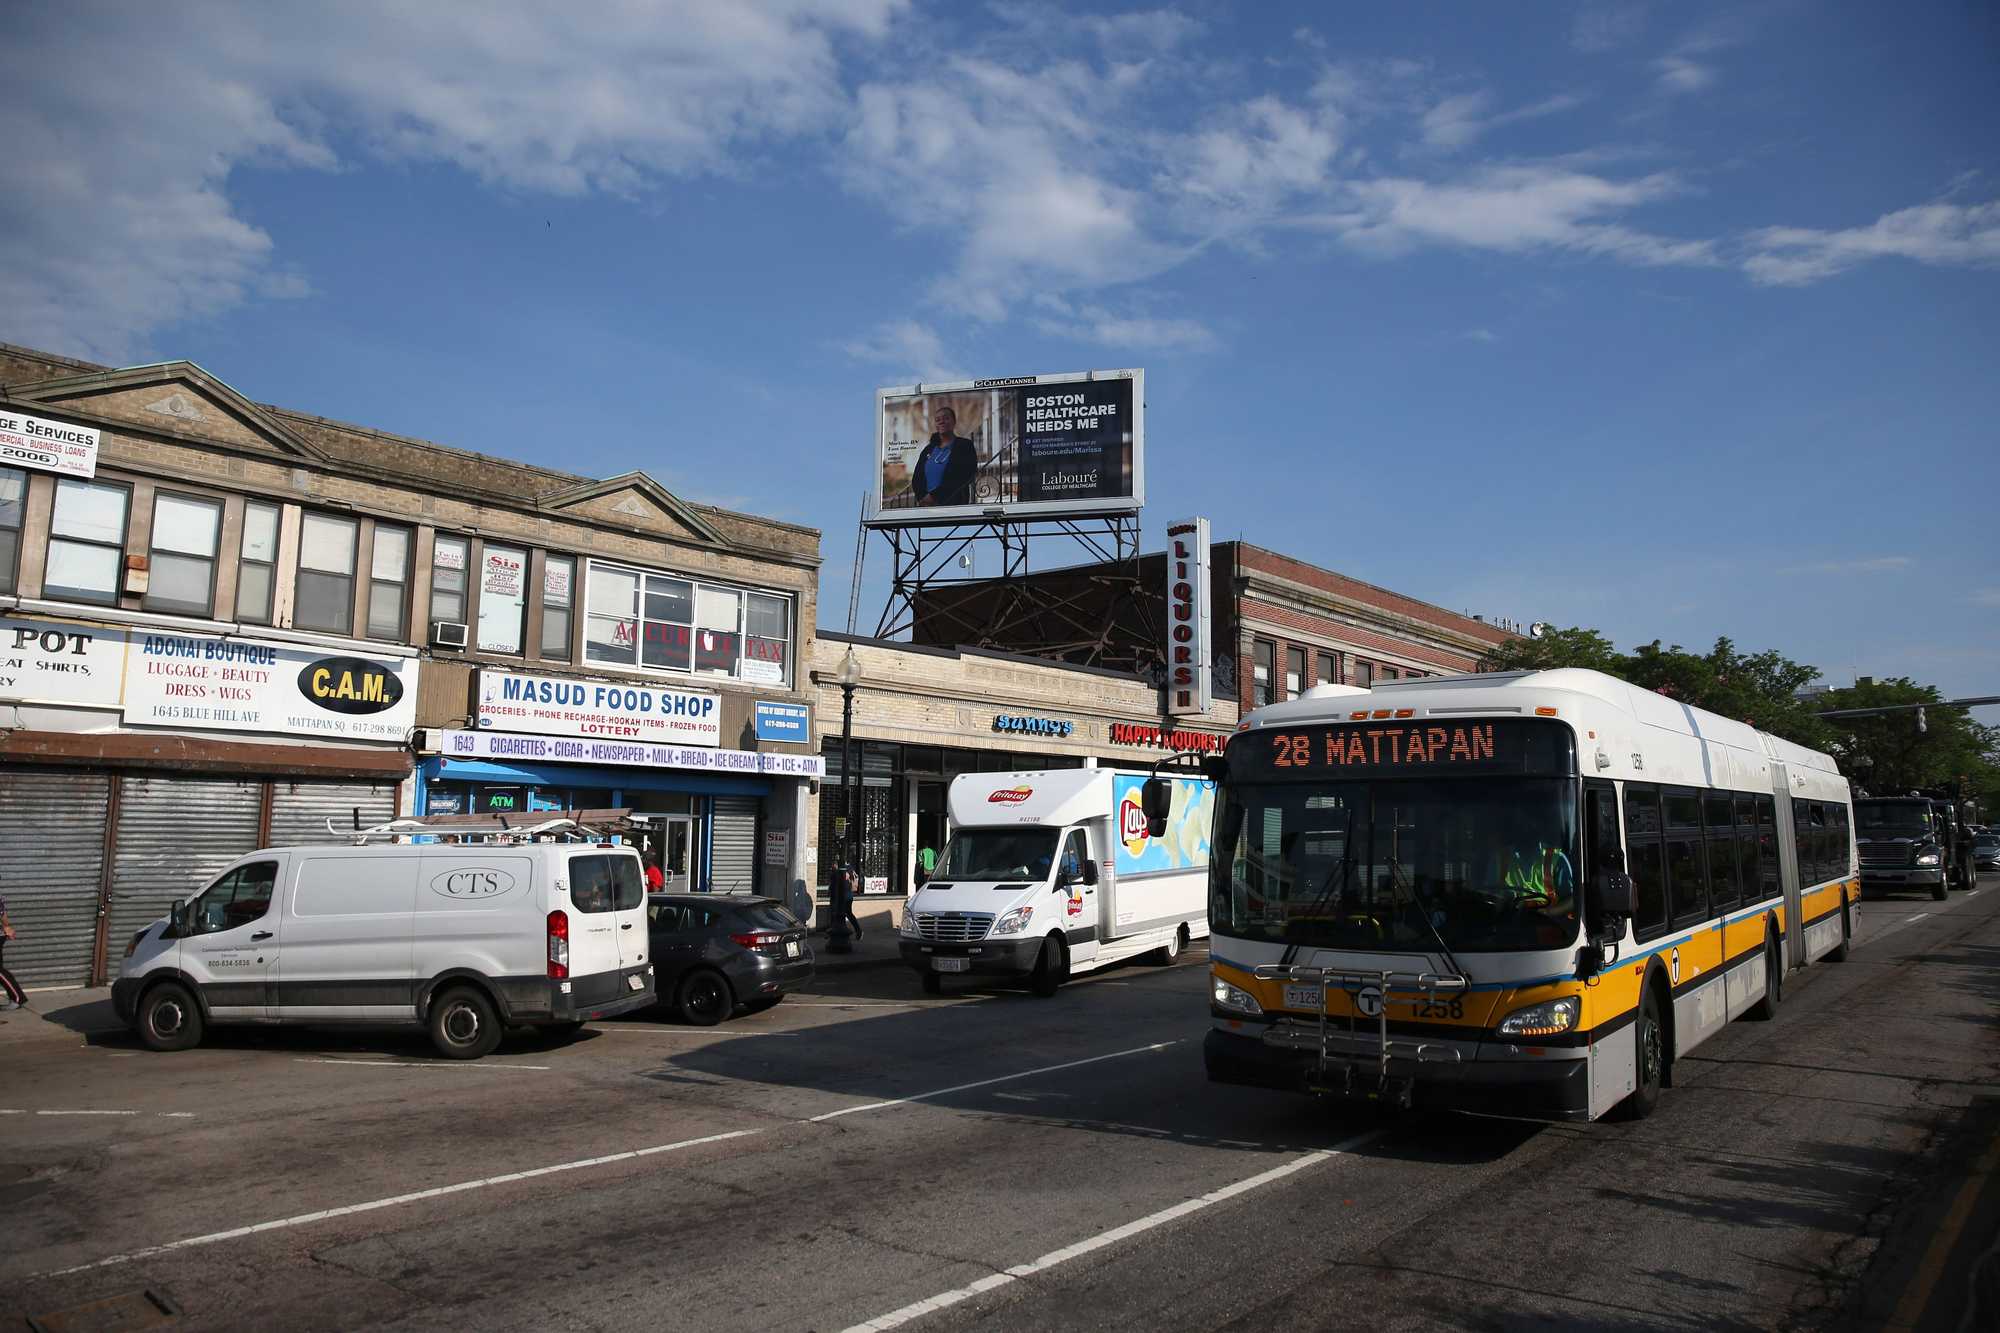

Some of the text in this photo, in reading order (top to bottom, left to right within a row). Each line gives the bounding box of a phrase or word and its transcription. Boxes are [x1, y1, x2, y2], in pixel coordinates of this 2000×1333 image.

[1026, 394, 1085, 408] BOSTON
[1026, 404, 1116, 421] HEALTHCARE
[26, 420, 94, 446] SERVICES
[1026, 418, 1098, 433] NEEDS ME
[3, 448, 50, 463] 2006
[30, 440, 63, 454] BUSINESS
[65, 445, 86, 458] LOANS
[1042, 468, 1097, 486] Labouré
[491, 556, 520, 569] Sia
[1173, 540, 1193, 686] LIQUORS
[11, 627, 93, 655] POT
[143, 636, 276, 665] ADONAI BOUTIQUE
[747, 639, 782, 660] TAX
[36, 660, 92, 676] SHIRTS,
[148, 661, 270, 684] LUGGAGE BEAUTY
[165, 683, 252, 701] DRESS WIGS
[312, 667, 391, 703] C.A.M.
[503, 678, 713, 717] MASUD FOOD SHOP
[152, 704, 179, 719] 1645
[182, 707, 209, 721] BLUE
[213, 708, 238, 722] HILL
[240, 710, 260, 724] AVE
[287, 716, 333, 730] MATTAPAN
[335, 719, 346, 732] SQ
[479, 705, 526, 716] GROCERIES
[534, 709, 561, 720] PHONE
[643, 718, 665, 728] ITEMS
[670, 721, 697, 731] FROZEN
[698, 724, 717, 733] FOOD
[580, 723, 640, 736] LOTTERY
[1114, 722, 1159, 746] HAPPY
[1163, 729, 1216, 752] LIQUORS
[453, 735, 817, 773] 1643 CIGARETTES CIGAR NEWSPAPER MILK BREAD ICE CREAM EBT ICE ATM
[1272, 724, 1495, 767] 28 MATTAPAN
[489, 795, 513, 807] ATM
[447, 872, 498, 894] CTS
[871, 880, 886, 891] OPEN
[1411, 997, 1464, 1020] 1258
